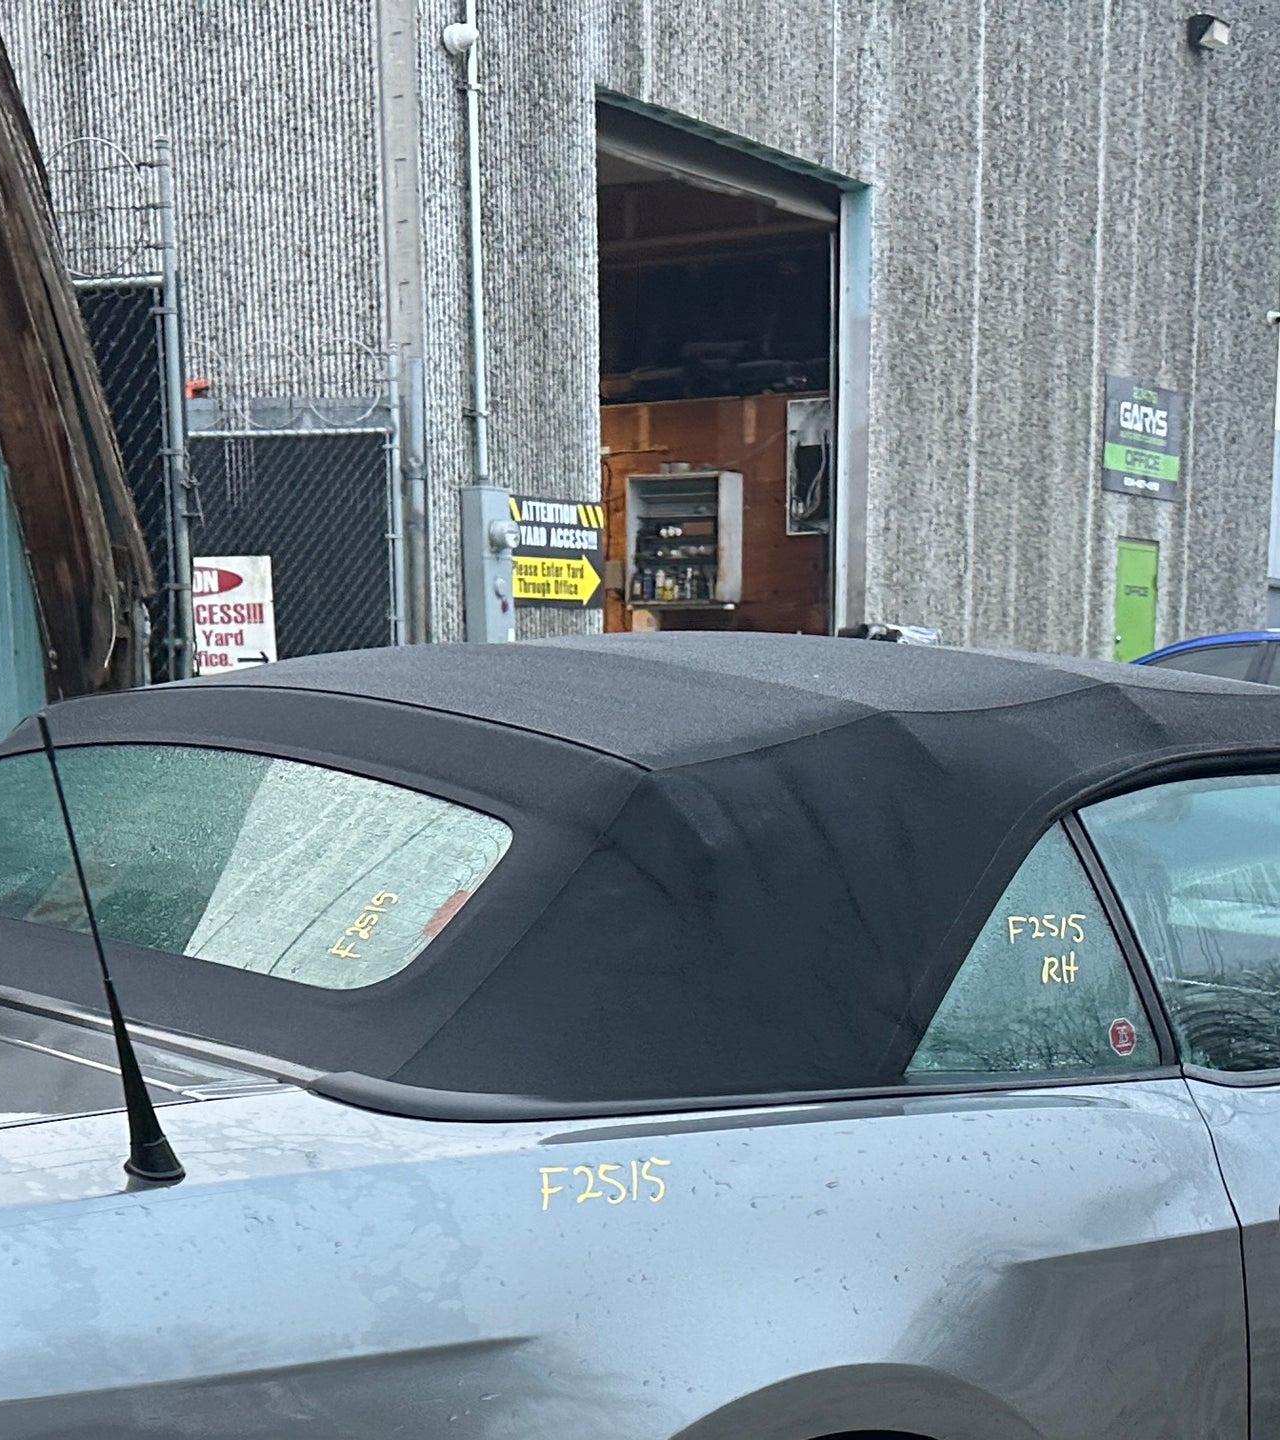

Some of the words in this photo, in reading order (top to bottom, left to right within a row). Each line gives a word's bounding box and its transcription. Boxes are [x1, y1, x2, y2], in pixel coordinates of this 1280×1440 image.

[521, 500, 578, 525] ATTENTION
[519, 525, 547, 547] YARD
[541, 562, 563, 578] Enter
[566, 563, 585, 579] Yard
[518, 577, 551, 597] Through
[554, 580, 578, 596] Office
[201, 629, 246, 647] Yard
[328, 890, 399, 959] F2515
[1007, 914, 1087, 944] F2515
[1041, 951, 1078, 984] RH
[538, 1156, 671, 1211] F2515
